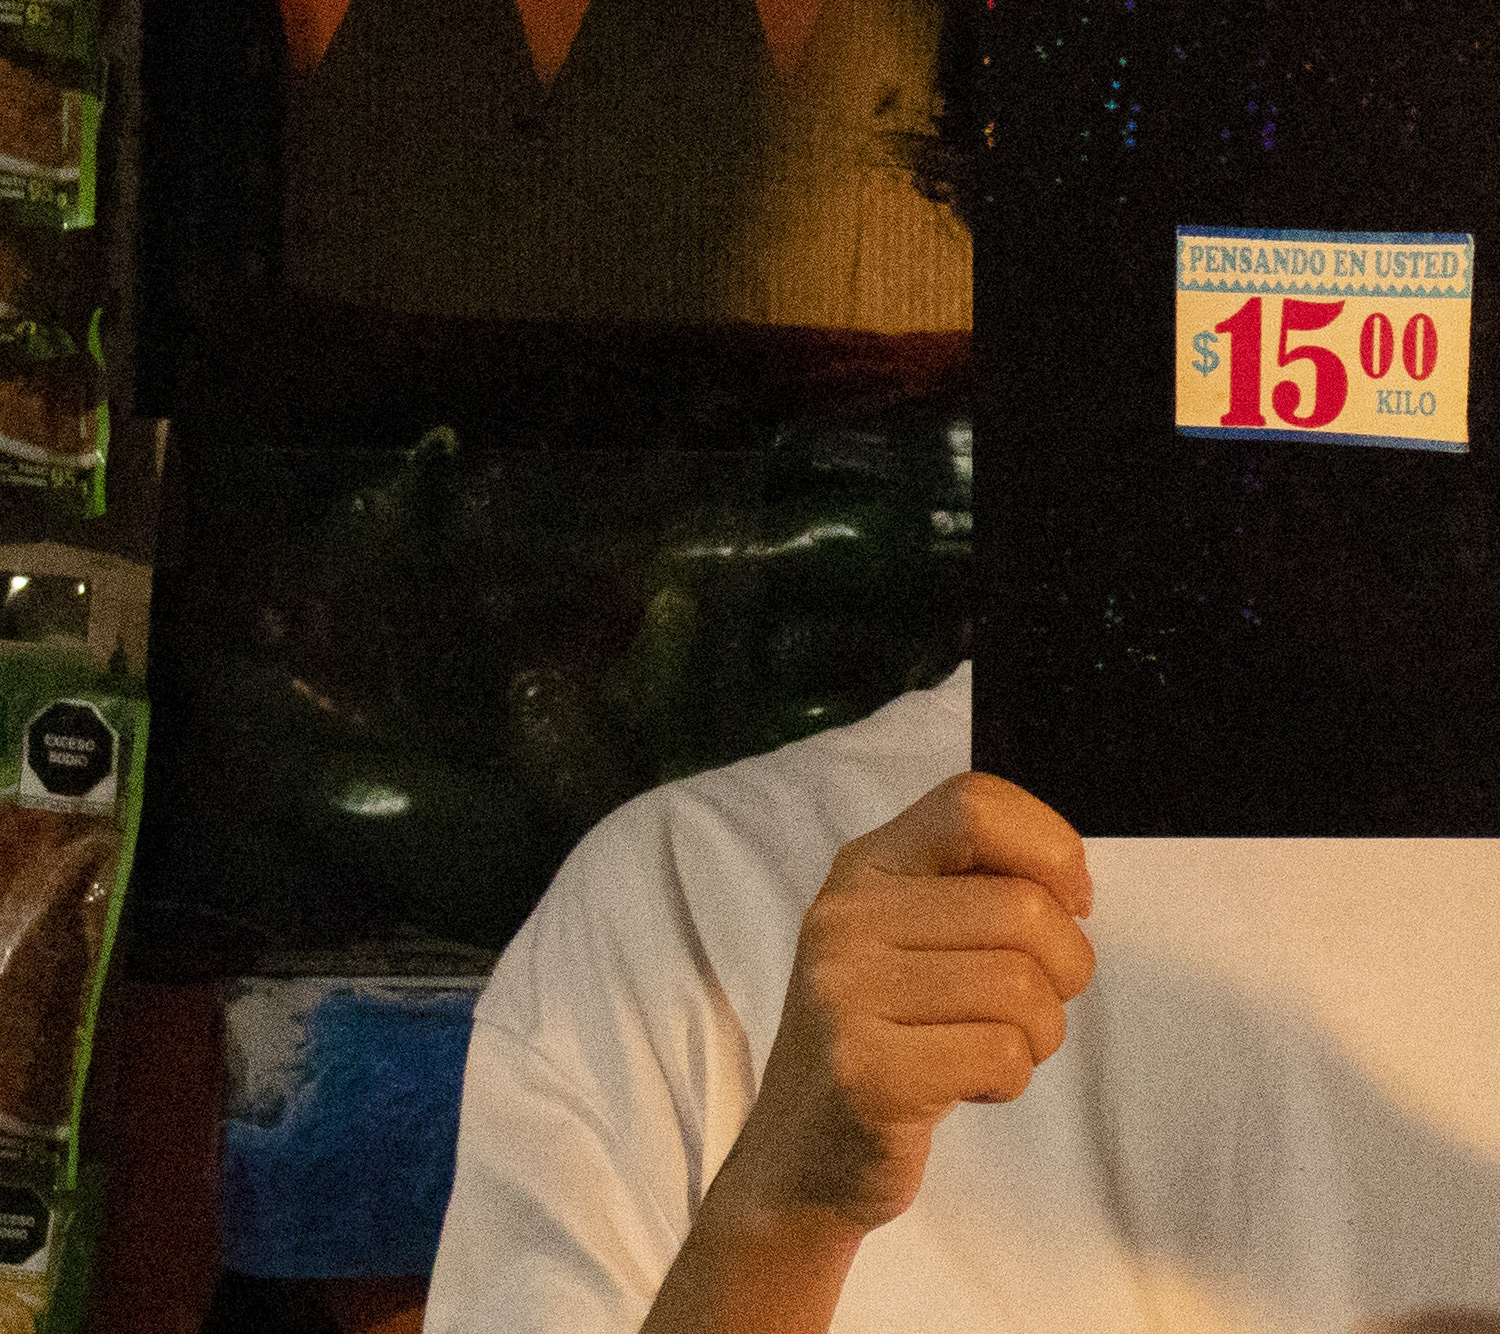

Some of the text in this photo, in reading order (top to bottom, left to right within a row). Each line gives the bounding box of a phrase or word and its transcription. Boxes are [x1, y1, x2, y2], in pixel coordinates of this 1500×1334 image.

[1189, 245, 1459, 279] PENSANDO EN USTED
[1376, 389, 1437, 416] KILO
[44, 733, 96, 752] EXCESO
